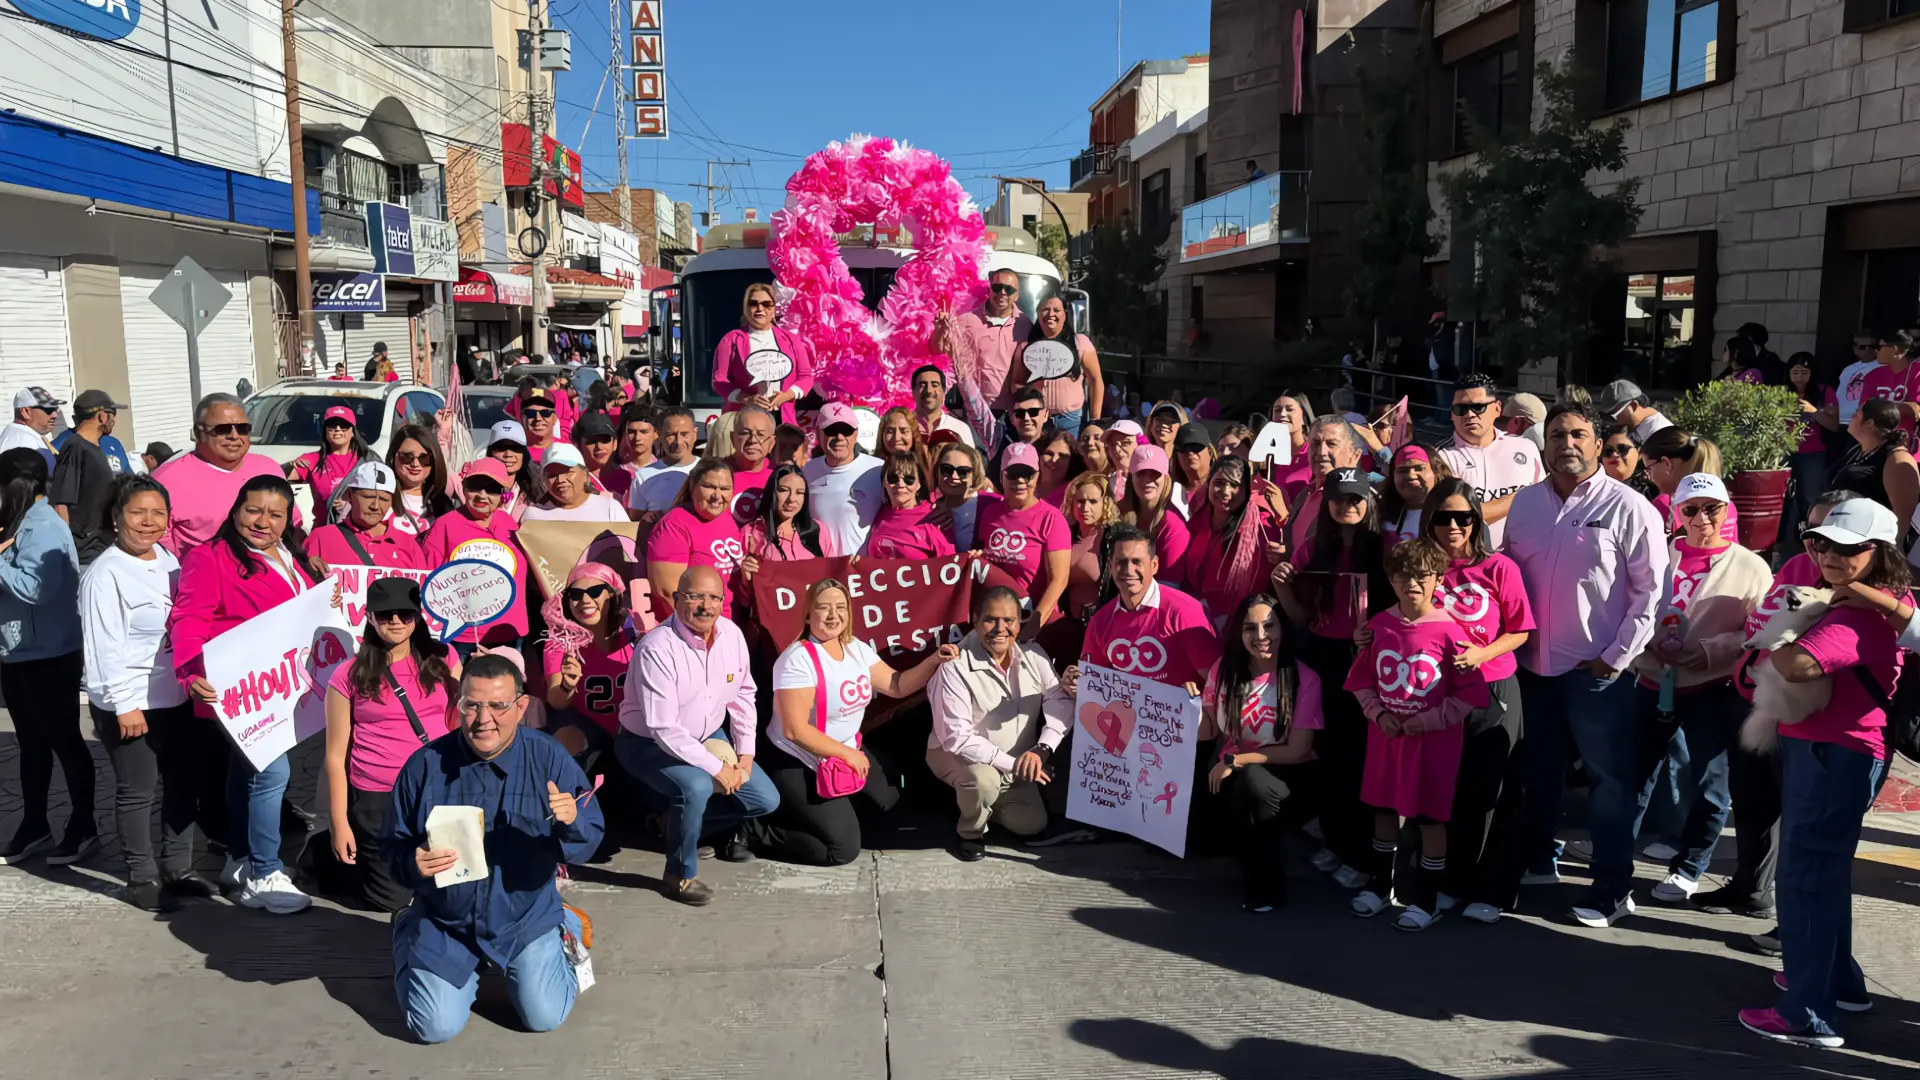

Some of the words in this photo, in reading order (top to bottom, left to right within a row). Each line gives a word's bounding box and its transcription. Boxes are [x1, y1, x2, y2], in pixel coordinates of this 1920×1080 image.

[311, 279, 379, 300] telcel
[775, 555, 991, 611] DECCIÓN
[862, 600, 912, 629] DE
